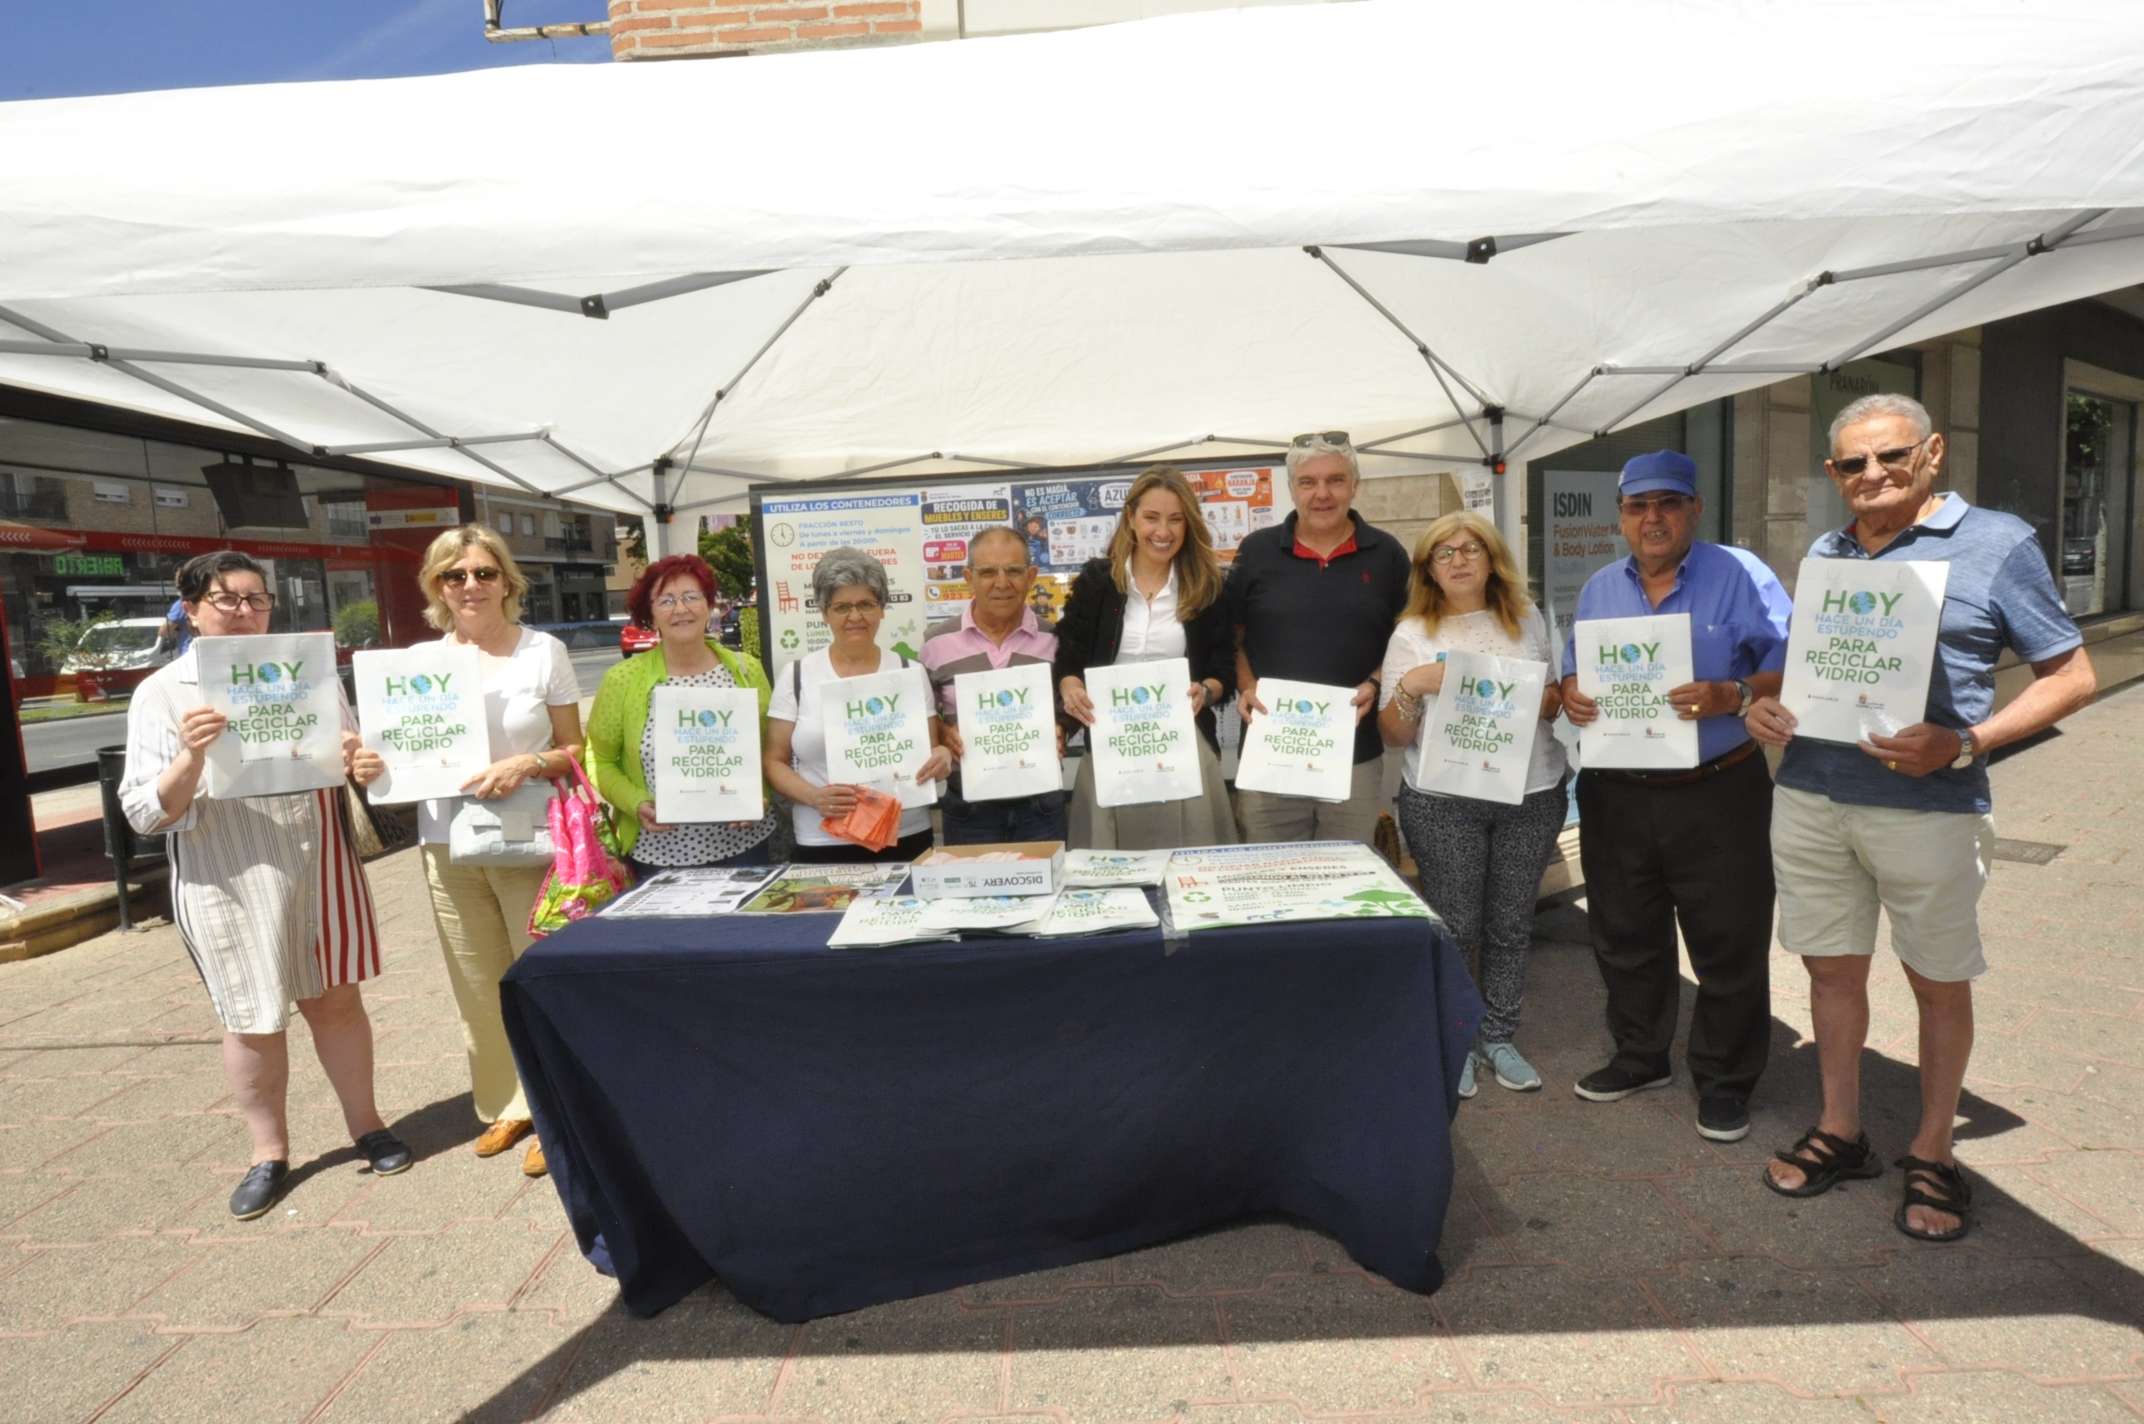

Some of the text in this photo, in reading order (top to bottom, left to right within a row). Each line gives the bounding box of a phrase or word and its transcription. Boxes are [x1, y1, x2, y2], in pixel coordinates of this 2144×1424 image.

[1228, 479, 1255, 487] NARANJA
[1024, 487, 1046, 498] NO ES
[1104, 489, 1130, 502] AZU
[770, 497, 912, 513] UTILIZA LOS CONTENEDORES
[1026, 492, 1078, 507] ES ACEPTAR
[1048, 501, 1080, 510] CONTENEDOR
[1554, 492, 1592, 518] ISDIN
[933, 500, 998, 513] RECOGIDA DE
[924, 510, 1008, 524] MUEBLES Y ENSERES
[1048, 509, 1081, 519] CORRECTO
[798, 520, 838, 530] FRACCIÓN
[1554, 524, 1609, 539] FusionWater
[811, 530, 832, 538] lunes
[874, 526, 911, 536] domingos
[944, 531, 971, 539] SERVICIO
[808, 538, 827, 548] partir
[830, 538, 839, 546] de
[840, 538, 851, 546] las
[792, 548, 897, 561] NO FUERA
[941, 550, 966, 560] MARTES
[1554, 542, 1615, 559] & Body Lotion
[791, 563, 804, 571] DE
[1822, 589, 1904, 617] HOY
[1814, 614, 1850, 625] HACE
[1855, 616, 1876, 626] UN
[1817, 624, 1898, 640] ESTUPENDO
[1829, 637, 1879, 654] PARA
[1600, 642, 1661, 665] HOY
[1805, 650, 1903, 672] RECICLAR
[231, 662, 304, 685] HOY
[1595, 664, 1624, 674] HACE
[1628, 664, 1644, 672] UN
[1814, 666, 1880, 685] VIDRIO
[1599, 672, 1664, 683] ESTUPENDO
[227, 686, 263, 696] HACE
[268, 684, 285, 694] UN
[386, 673, 453, 697] HOY
[1460, 676, 1516, 701] HOY
[1612, 683, 1652, 695] PARA
[232, 692, 308, 704] ESTUPENDO
[382, 696, 415, 706] HACE
[419, 694, 436, 704] UN
[978, 687, 1029, 710] HOY
[1112, 684, 1166, 707] HOY
[1454, 696, 1477, 706] HACE
[1480, 699, 1494, 707] UN
[248, 704, 296, 717] PARA
[386, 703, 457, 715] ESTUPENDO
[846, 694, 900, 720] HOY
[975, 708, 1000, 718] HACE
[1108, 706, 1136, 716] HACE
[1138, 704, 1153, 712] UN
[1276, 698, 1331, 716] HOY
[1455, 704, 1512, 719] ESTUPENDO
[401, 714, 445, 727] PARA
[678, 710, 734, 728] HOY
[978, 712, 1033, 725] ESTUPENDO
[1112, 710, 1171, 723] ESTUPENDO
[1270, 712, 1297, 720] HACE
[1604, 708, 1659, 720] VIDRIO
[227, 714, 318, 733] RECICLAR
[844, 718, 870, 729] HACE
[874, 715, 888, 725] UN
[848, 720, 906, 736] ESTUPENDO
[990, 722, 1024, 734] PARA
[1124, 722, 1161, 734] PARA
[1272, 719, 1331, 729] ESTUPENDO
[1462, 714, 1497, 730] PARA
[239, 728, 304, 744] VIDRIO
[382, 724, 467, 742] RECICLAR
[674, 728, 701, 736] HACE
[704, 728, 719, 736] UN
[1282, 726, 1318, 737] PARA
[1444, 724, 1514, 745] RECICLAR
[393, 738, 453, 752] VIDRIO
[860, 732, 896, 746] PARA
[974, 730, 1040, 747] RECICLAR
[1108, 730, 1179, 748] RECICLAR
[1264, 734, 1334, 749] RECICLAR
[1450, 736, 1499, 754] VIDRIO
[689, 745, 726, 755] PARA
[844, 739, 914, 760] RECICLAR
[983, 742, 1030, 756] VIDRIO
[1118, 744, 1168, 757] VIDRIO
[1272, 744, 1321, 757] VIDRIO
[672, 756, 743, 767] RECICLAR
[854, 752, 903, 769] VIDRIO
[680, 767, 731, 778] VIDRIO
[968, 880, 978, 888] 75
[875, 898, 943, 907] HOY
